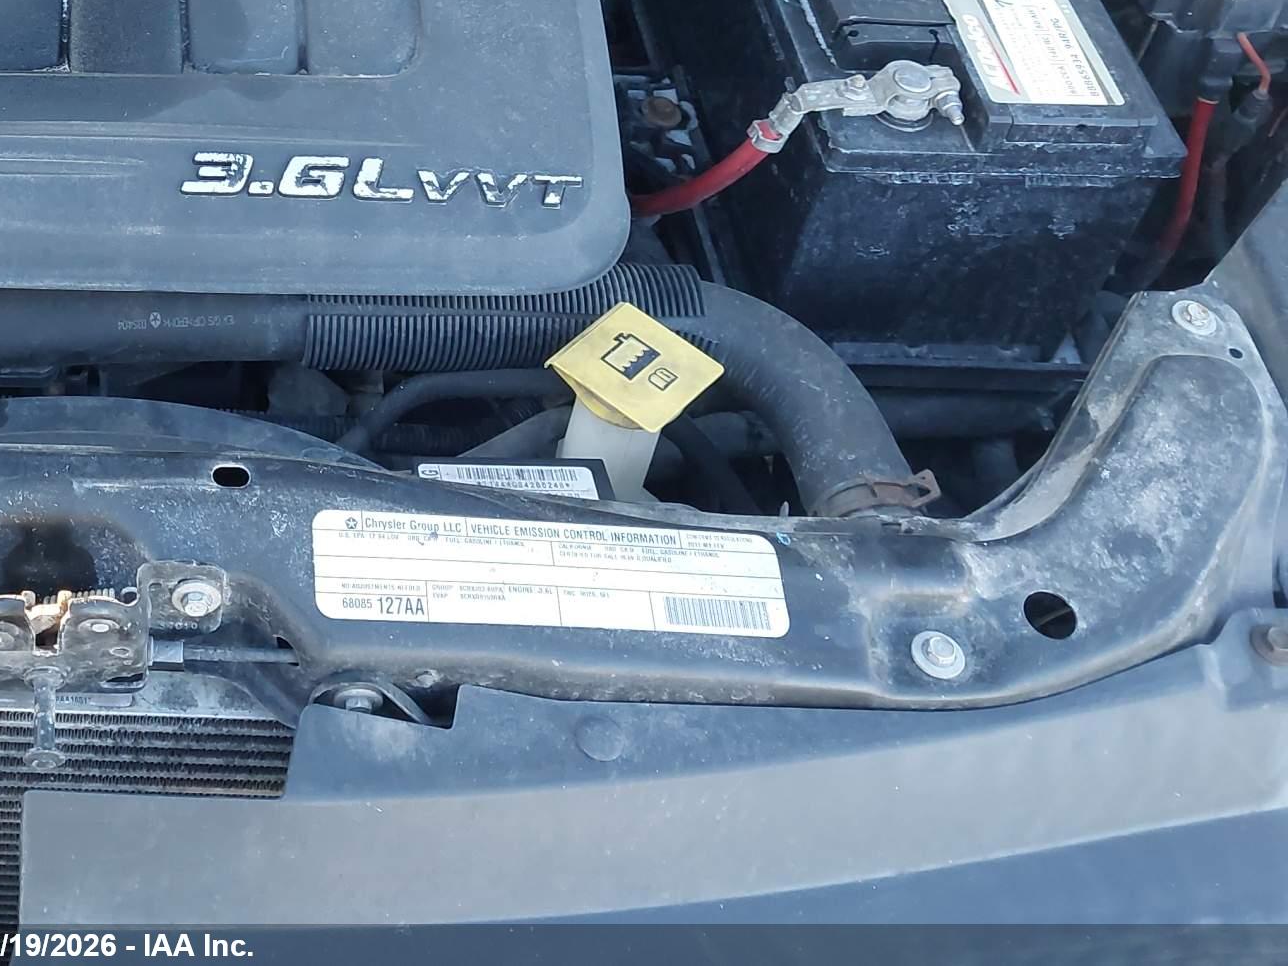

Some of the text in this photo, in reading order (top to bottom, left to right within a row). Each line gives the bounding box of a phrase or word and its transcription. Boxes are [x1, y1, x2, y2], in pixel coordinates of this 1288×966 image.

[364, 517, 463, 534] Chrysler Group LLC
[470, 523, 677, 546] VEHICLE EMISSION CONTROL INFORMATION
[342, 597, 425, 616] 68085 127AA
